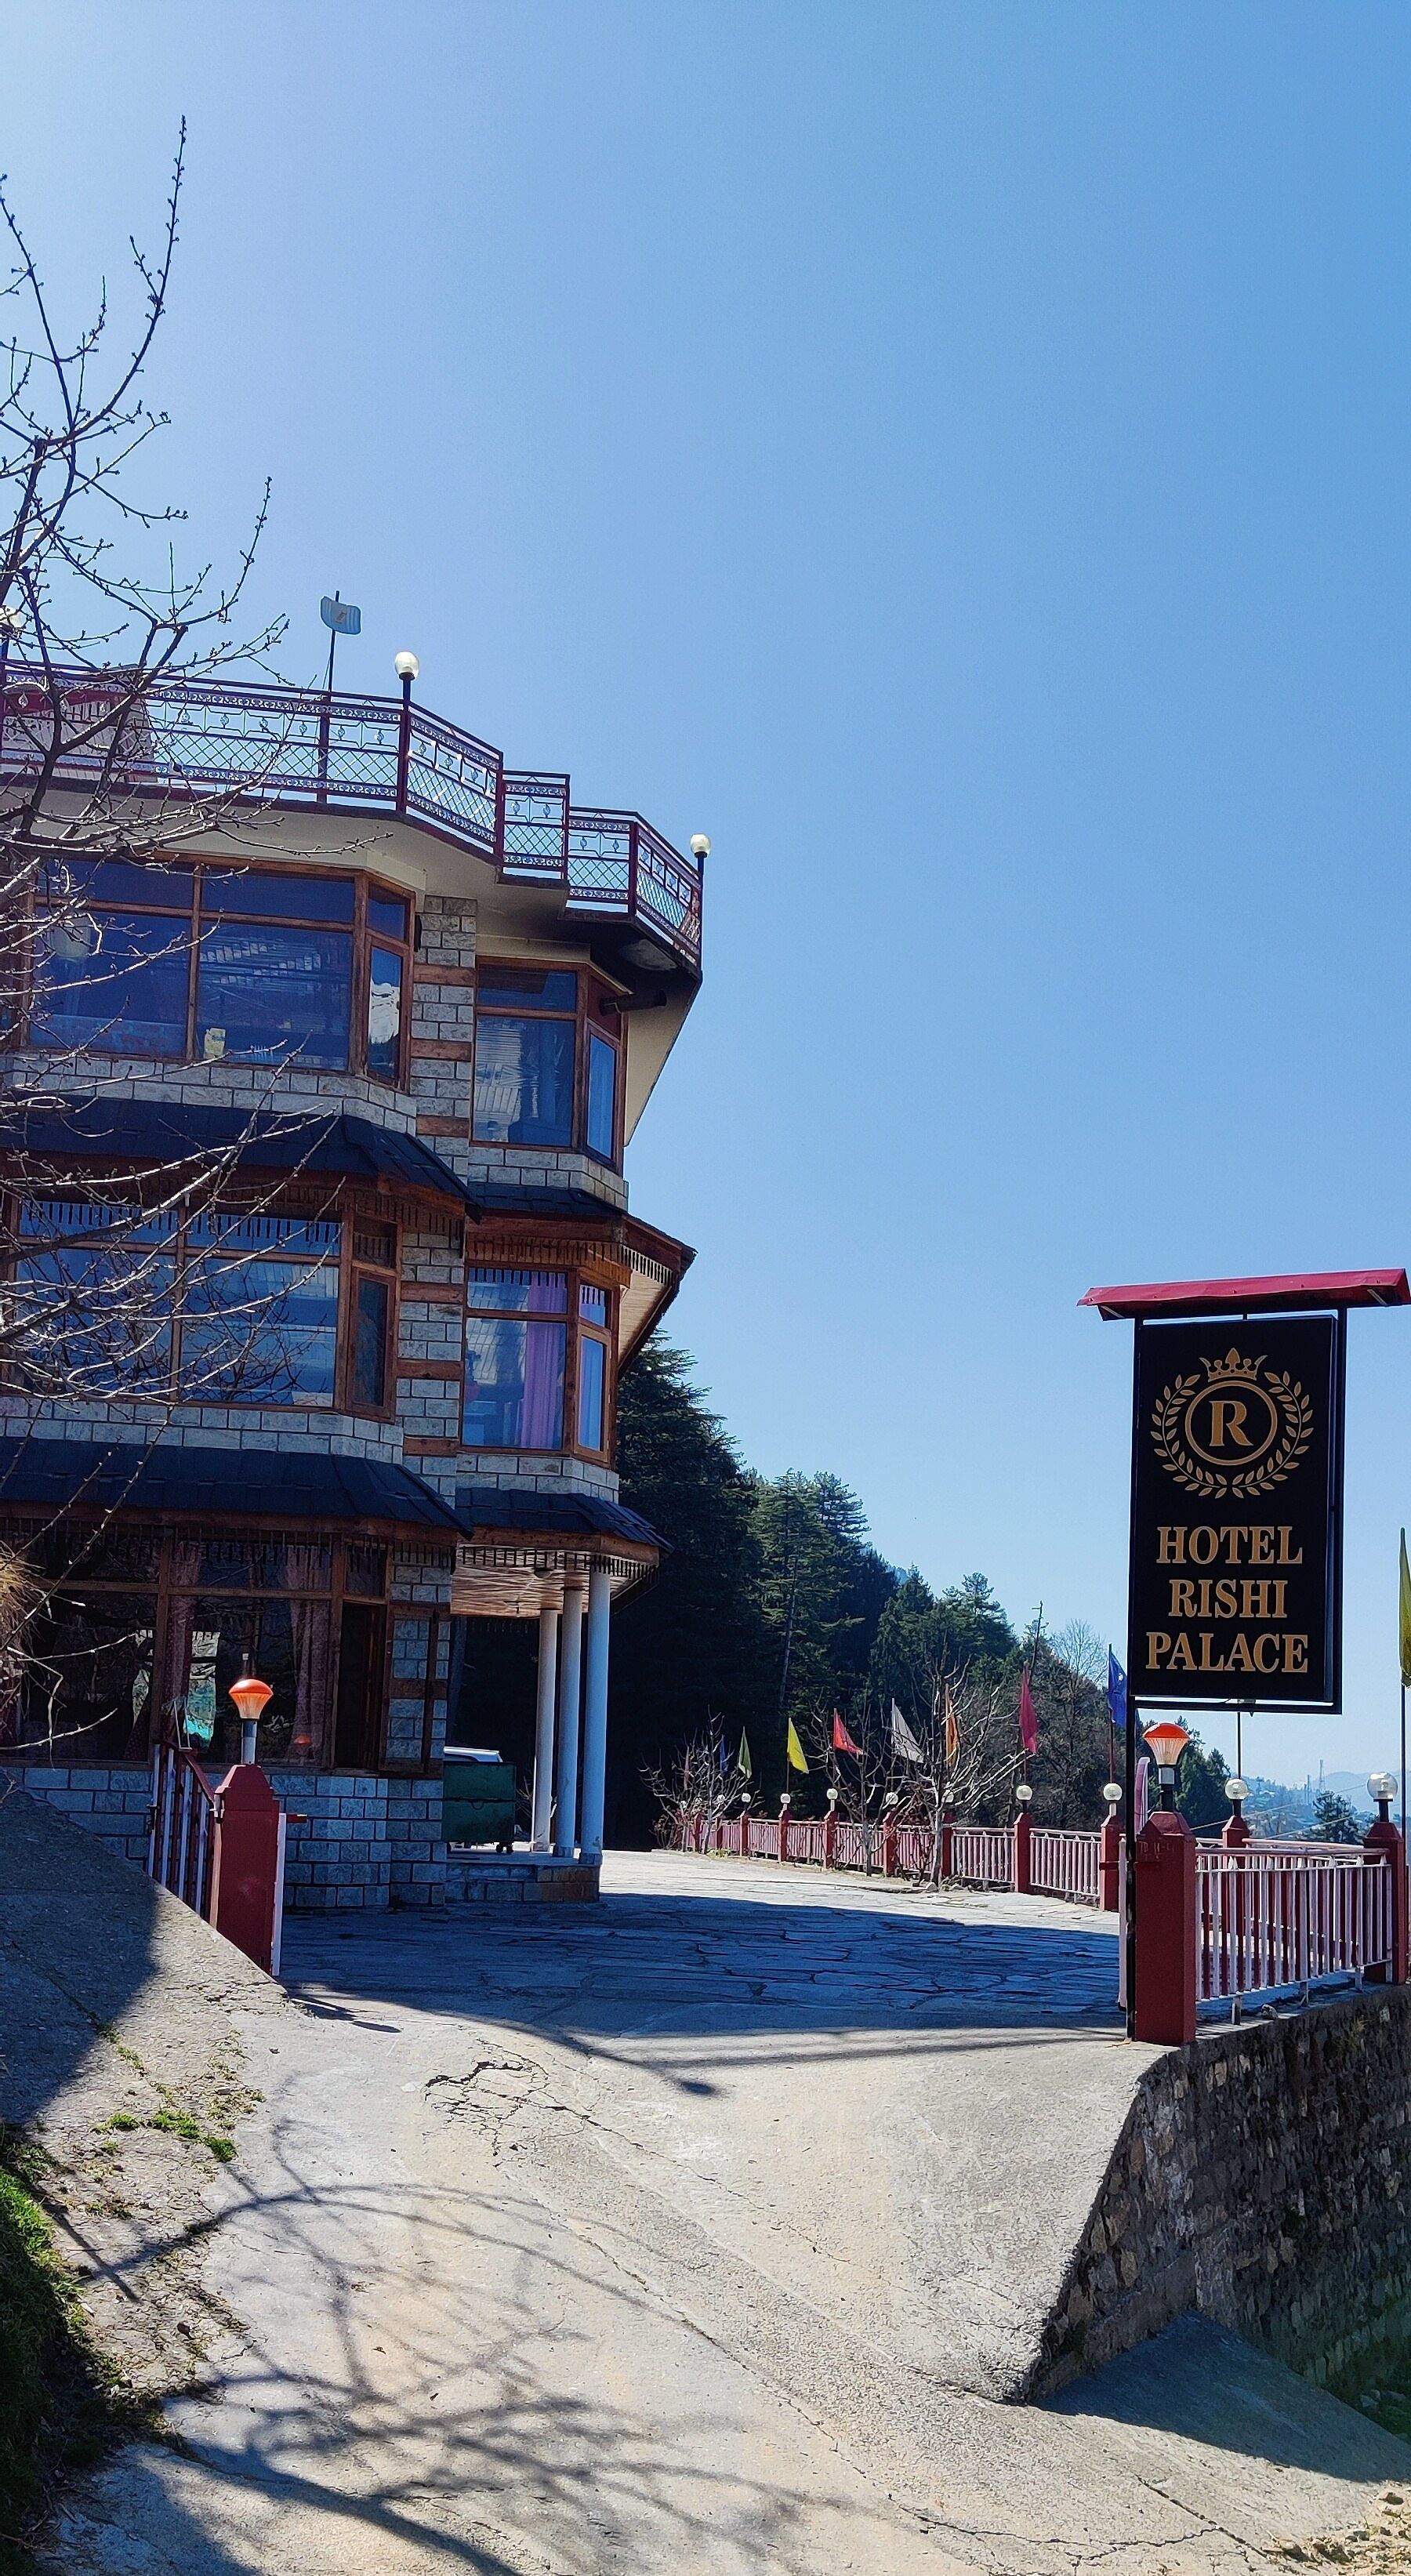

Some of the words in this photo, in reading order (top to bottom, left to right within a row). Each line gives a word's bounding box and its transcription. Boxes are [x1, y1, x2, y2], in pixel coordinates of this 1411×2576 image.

[1210, 1401, 1253, 1446] R
[1156, 1526, 1302, 1564] HOTEL
[1169, 1580, 1287, 1618] RISHI
[1146, 1632, 1308, 1673] PALACE
